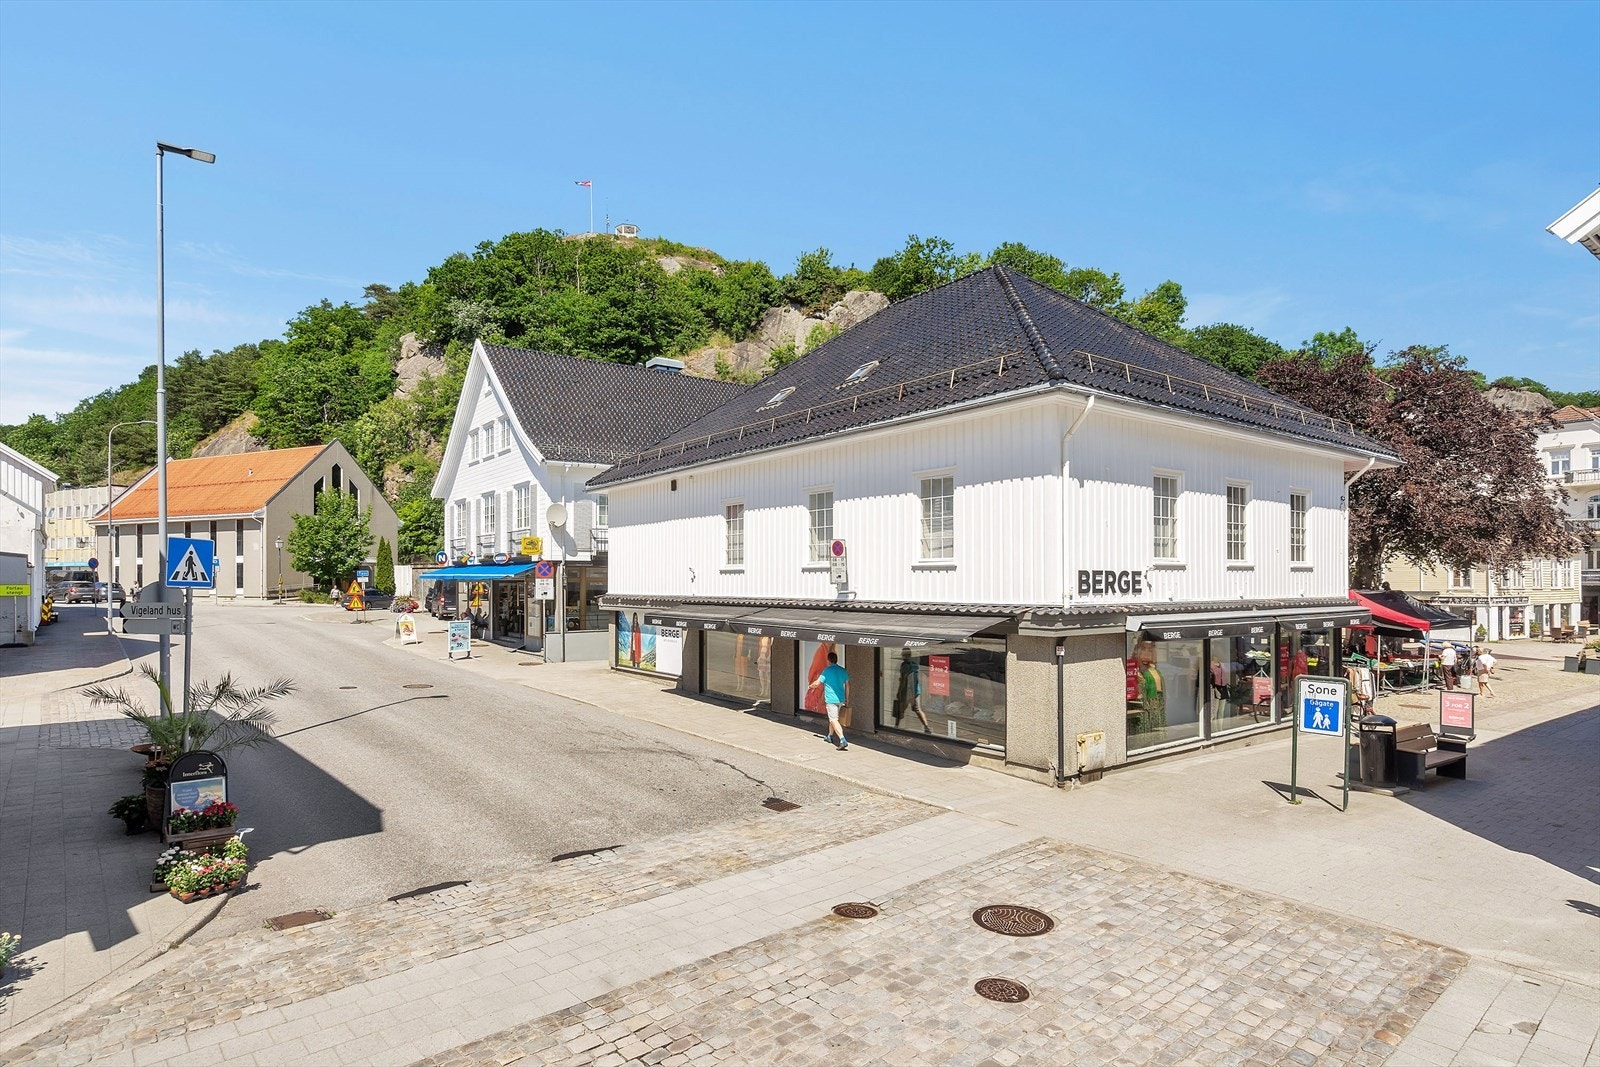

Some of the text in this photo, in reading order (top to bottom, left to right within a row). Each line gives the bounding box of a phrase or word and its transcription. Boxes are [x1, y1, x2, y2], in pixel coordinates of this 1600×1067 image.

[1078, 570, 1142, 593] BERGE
[131, 606, 181, 617] Vigeland hus
[661, 629, 680, 639] BERGE
[748, 627, 762, 635] BERGE
[1208, 629, 1223, 637] BERGE
[817, 634, 836, 642] BERGE
[930, 664, 935, 672] 3
[1308, 684, 1337, 696] Sone
[1310, 699, 1334, 708] Gågate
